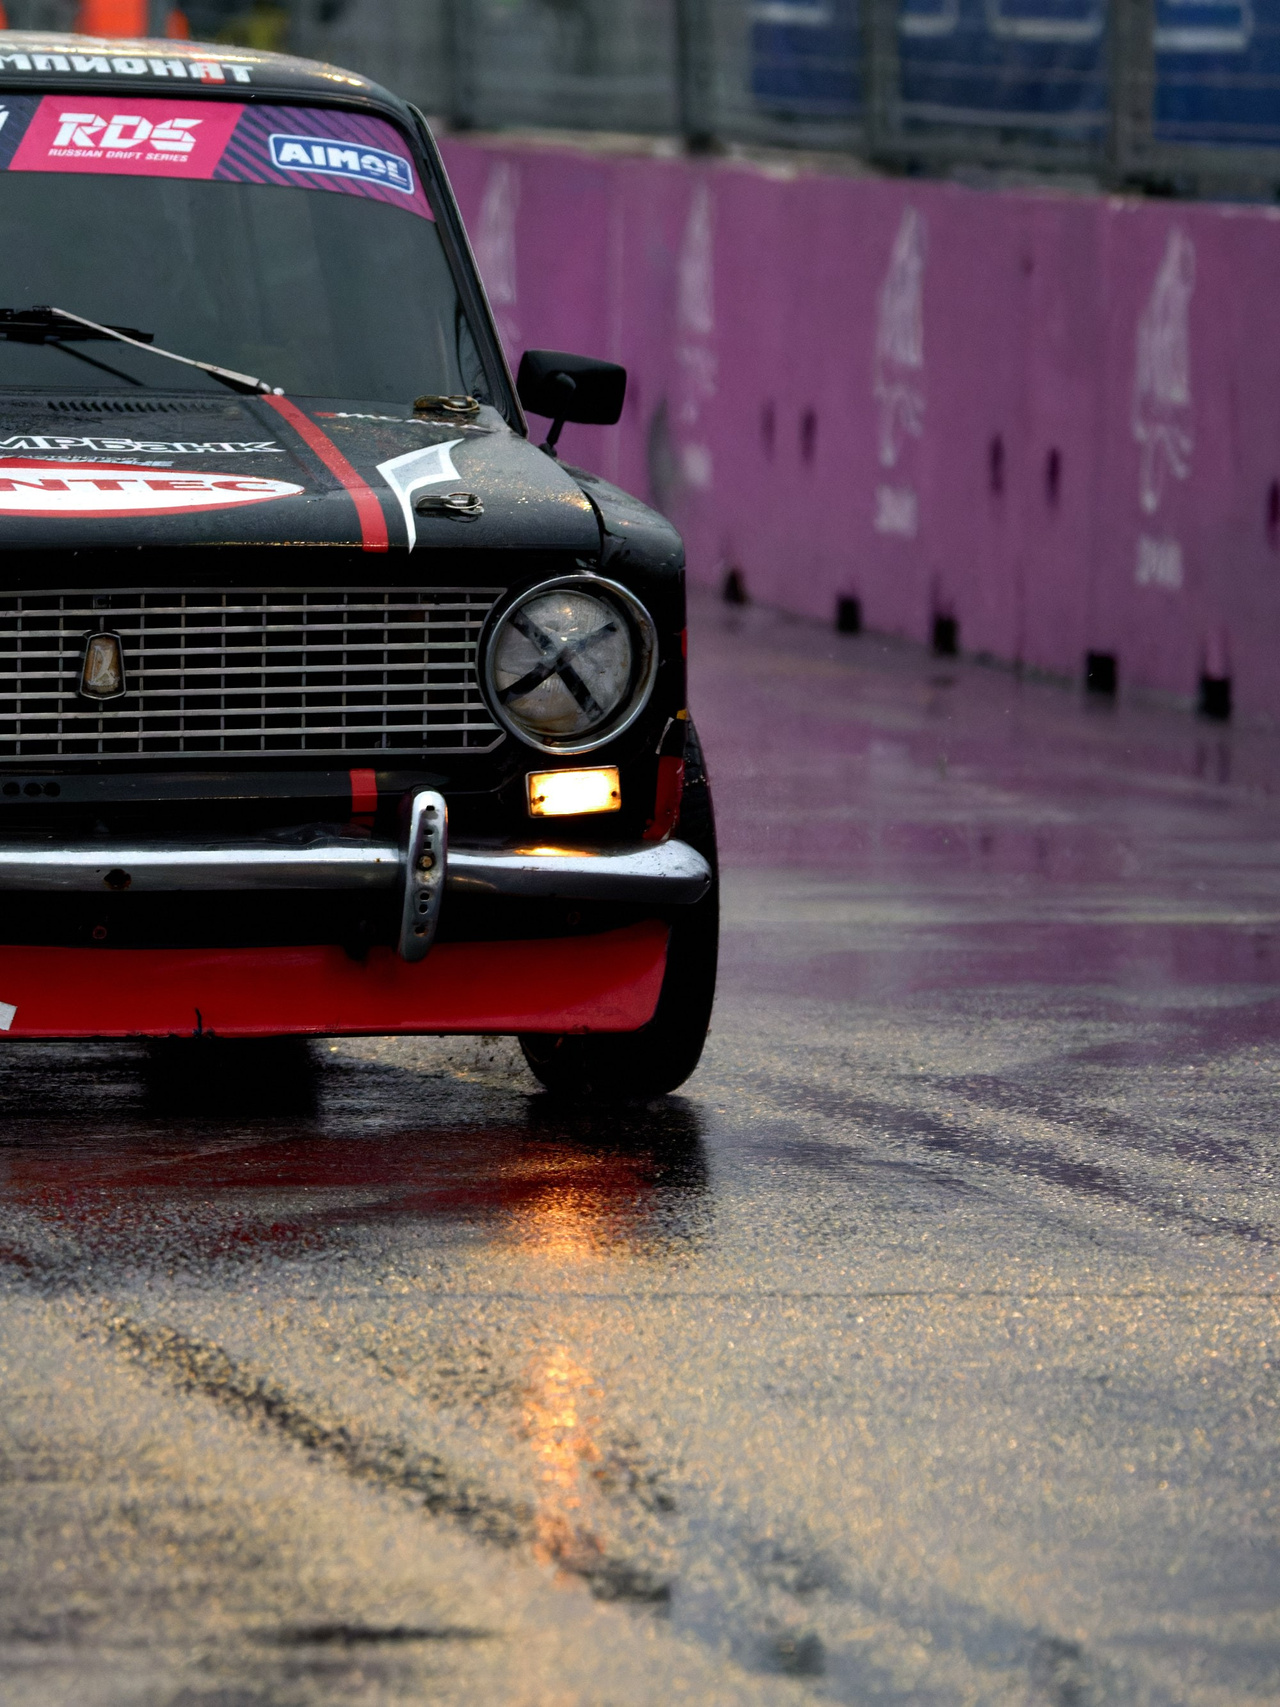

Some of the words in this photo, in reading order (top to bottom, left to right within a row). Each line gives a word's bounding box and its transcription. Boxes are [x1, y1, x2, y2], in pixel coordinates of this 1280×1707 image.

[52, 113, 204, 152] RDS
[48, 148, 104, 159] RUSSIAN
[105, 150, 142, 161] DRIFT
[145, 152, 189, 163] SERIES
[278, 142, 408, 185] AIMOL
